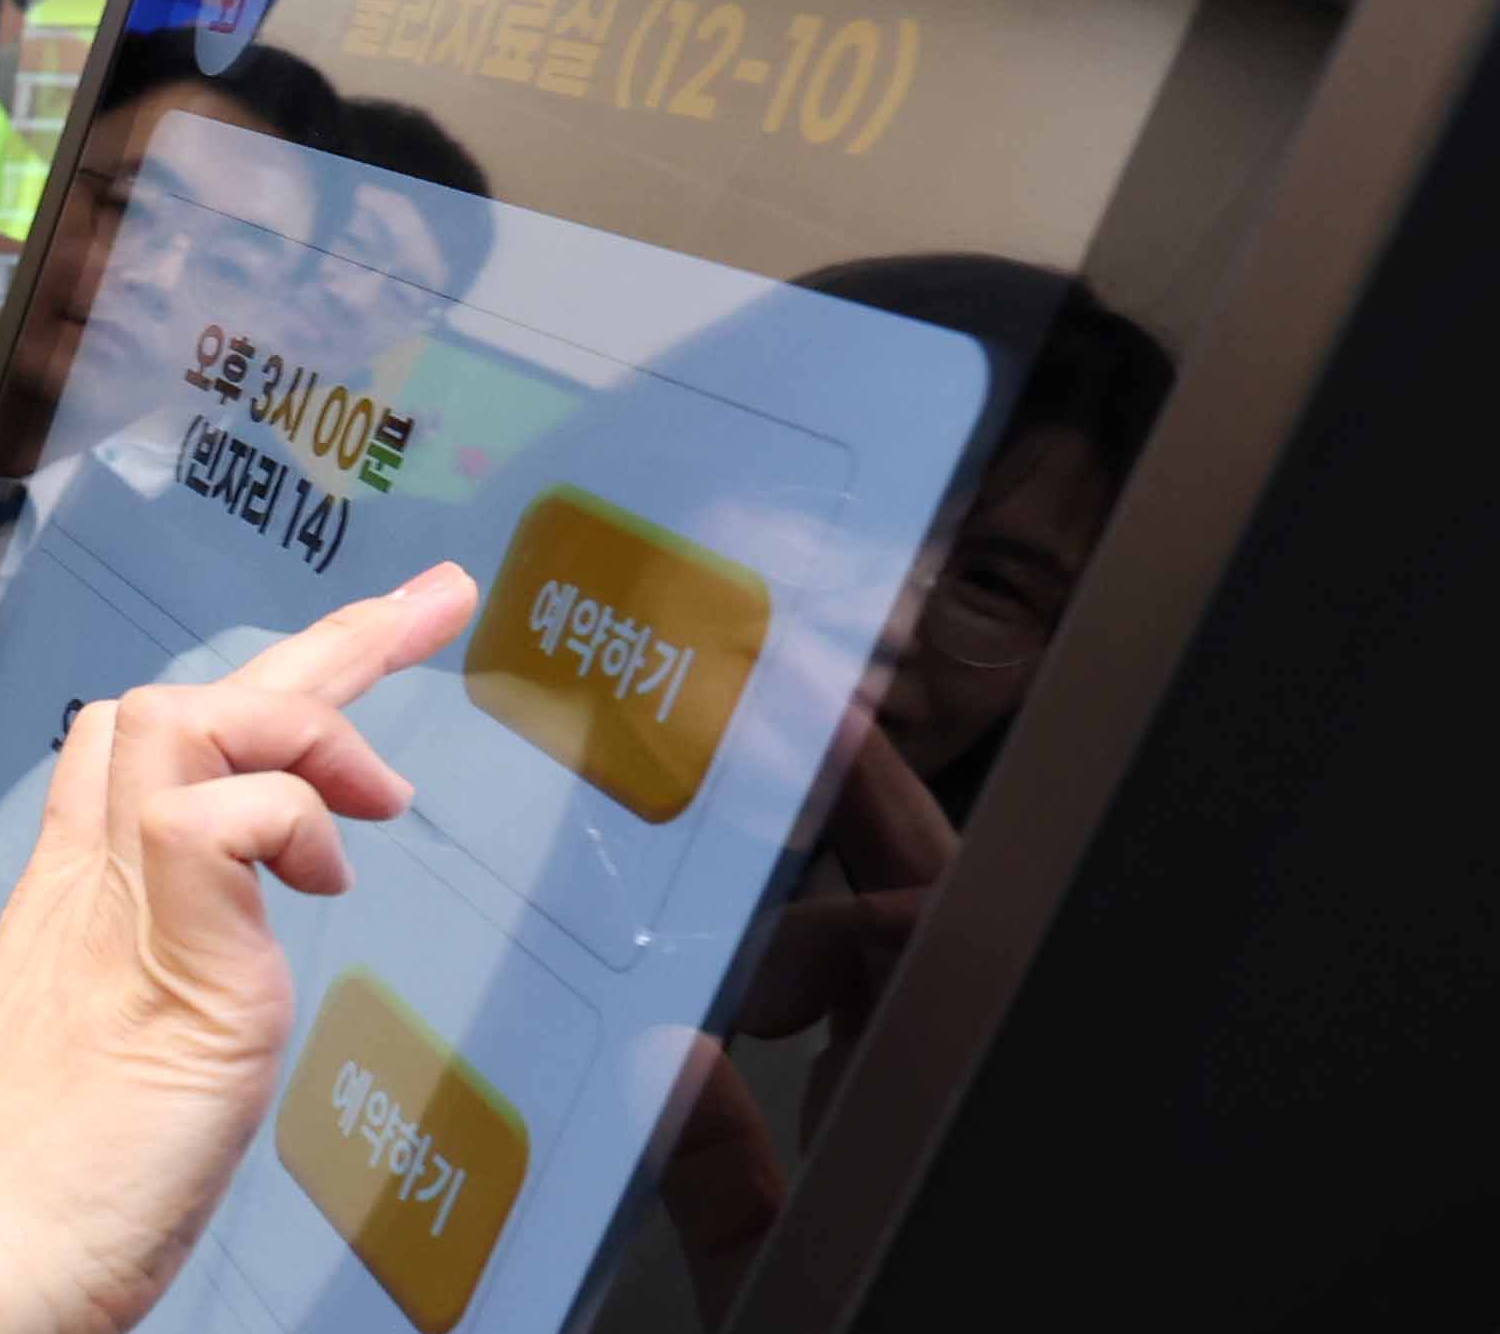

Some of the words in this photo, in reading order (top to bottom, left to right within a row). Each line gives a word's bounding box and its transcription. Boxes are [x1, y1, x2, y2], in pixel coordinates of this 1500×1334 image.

[184, 323, 256, 406] 오후
[250, 353, 319, 443] 3시
[312, 384, 415, 495] 00분
[175, 414, 289, 535] (빈자리
[280, 476, 352, 576] 14)
[529, 578, 697, 724] 예약하기
[331, 1058, 468, 1239] 예약하기
